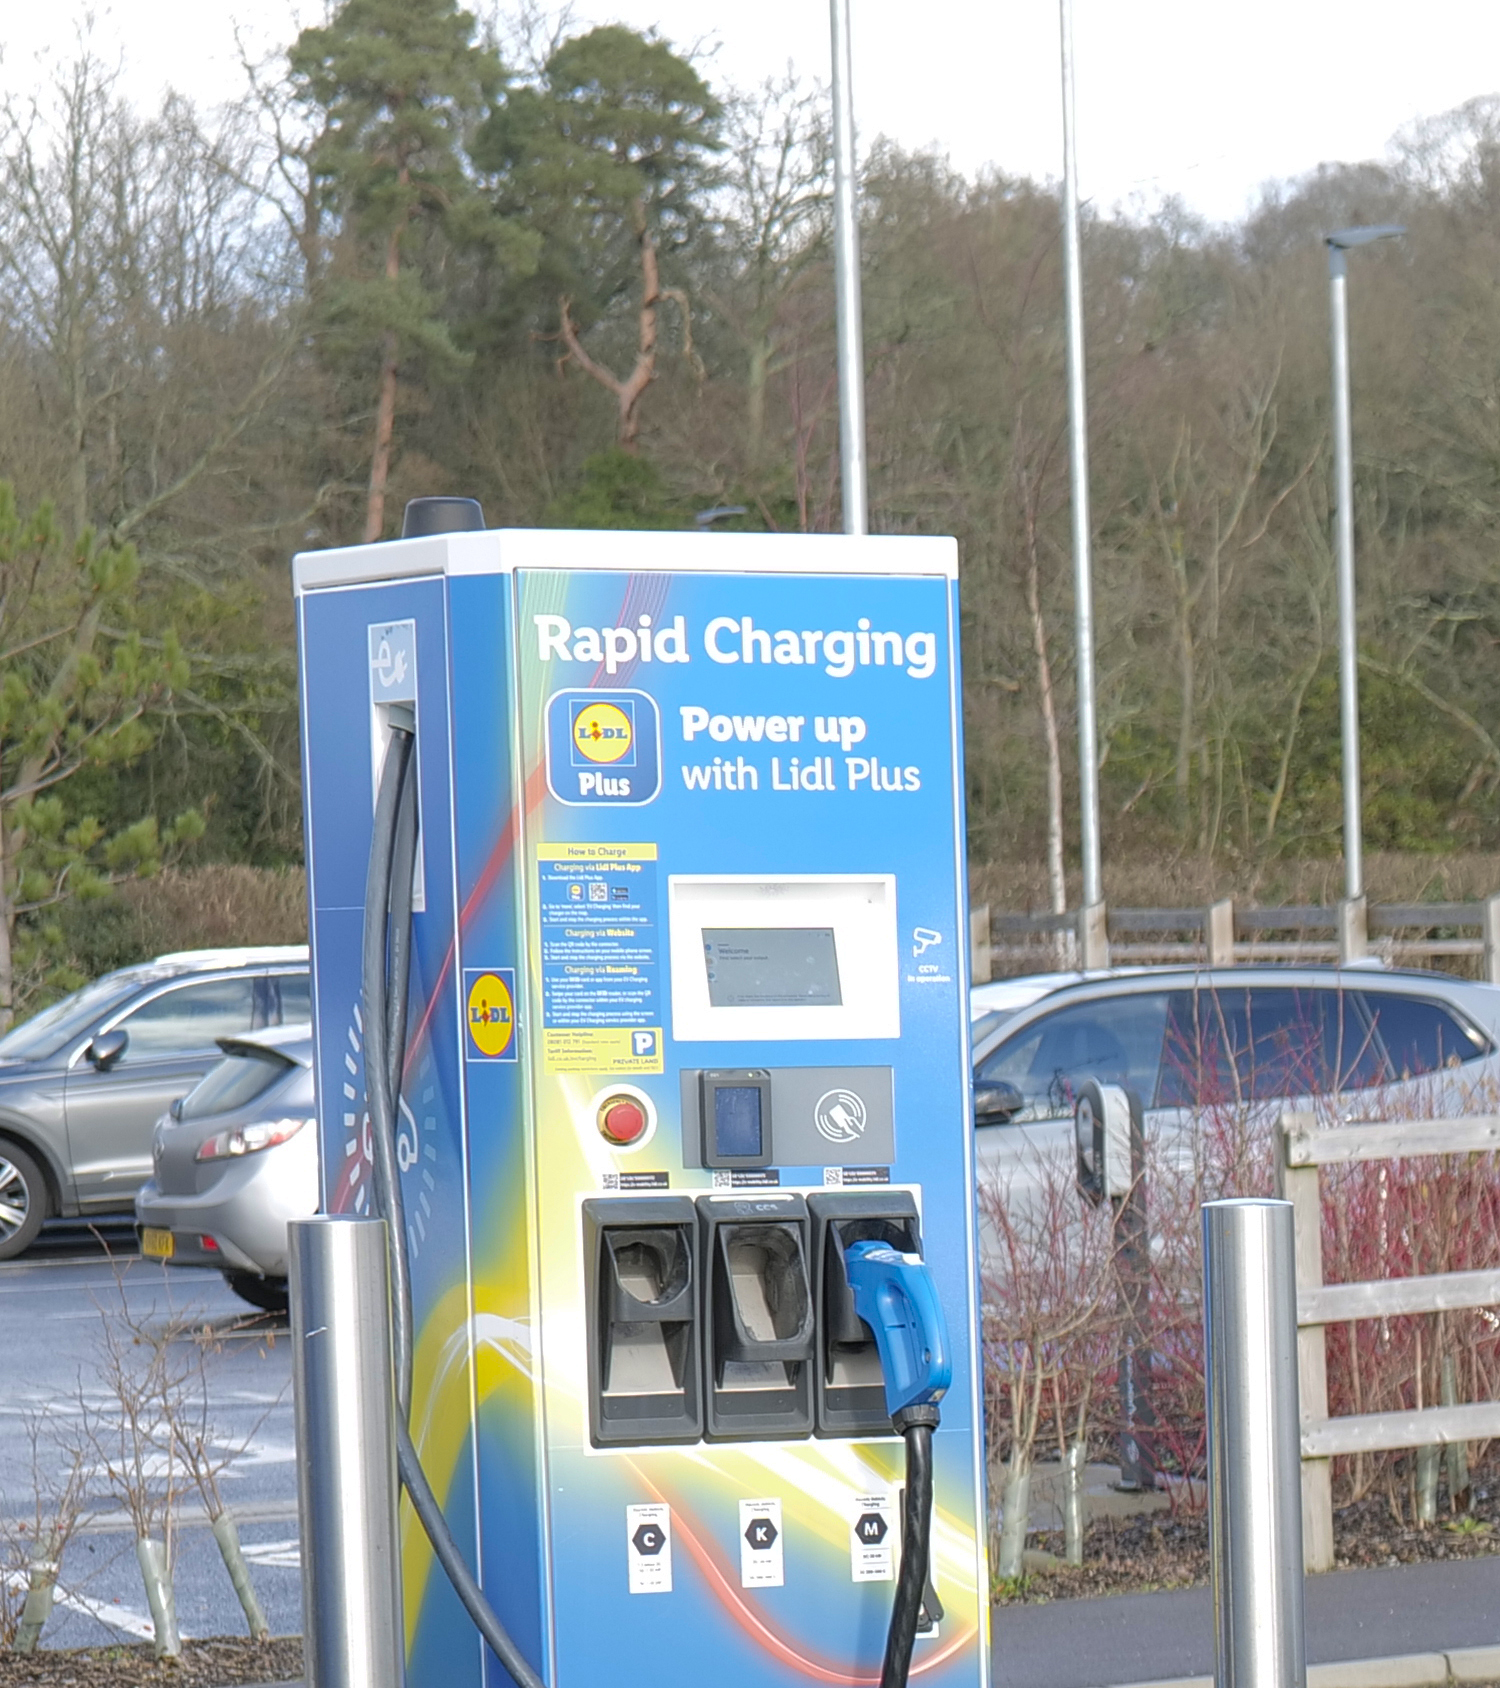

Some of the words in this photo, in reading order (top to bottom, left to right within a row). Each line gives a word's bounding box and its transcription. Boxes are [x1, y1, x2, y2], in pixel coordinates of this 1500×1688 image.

[533, 614, 690, 674] Rapid
[704, 616, 936, 679] Charging
[679, 706, 805, 743] Power
[815, 715, 866, 751] up
[681, 756, 758, 791] with
[771, 757, 835, 792] Lidl
[845, 757, 921, 792] Plus
[578, 772, 630, 797] Plus
[567, 847, 586, 856] How
[588, 848, 596, 856] to
[598, 847, 627, 858] Charge
[554, 863, 584, 873] Charging
[610, 863, 625, 872] Plus
[626, 863, 641, 873] App
[565, 928, 595, 938] Charging
[564, 965, 594, 975] Charging
[918, 965, 939, 973] CCTV
[633, 1032, 653, 1055] P
[755, 1527, 768, 1542] K
[864, 1522, 879, 1537] M
[643, 1532, 655, 1547] C
